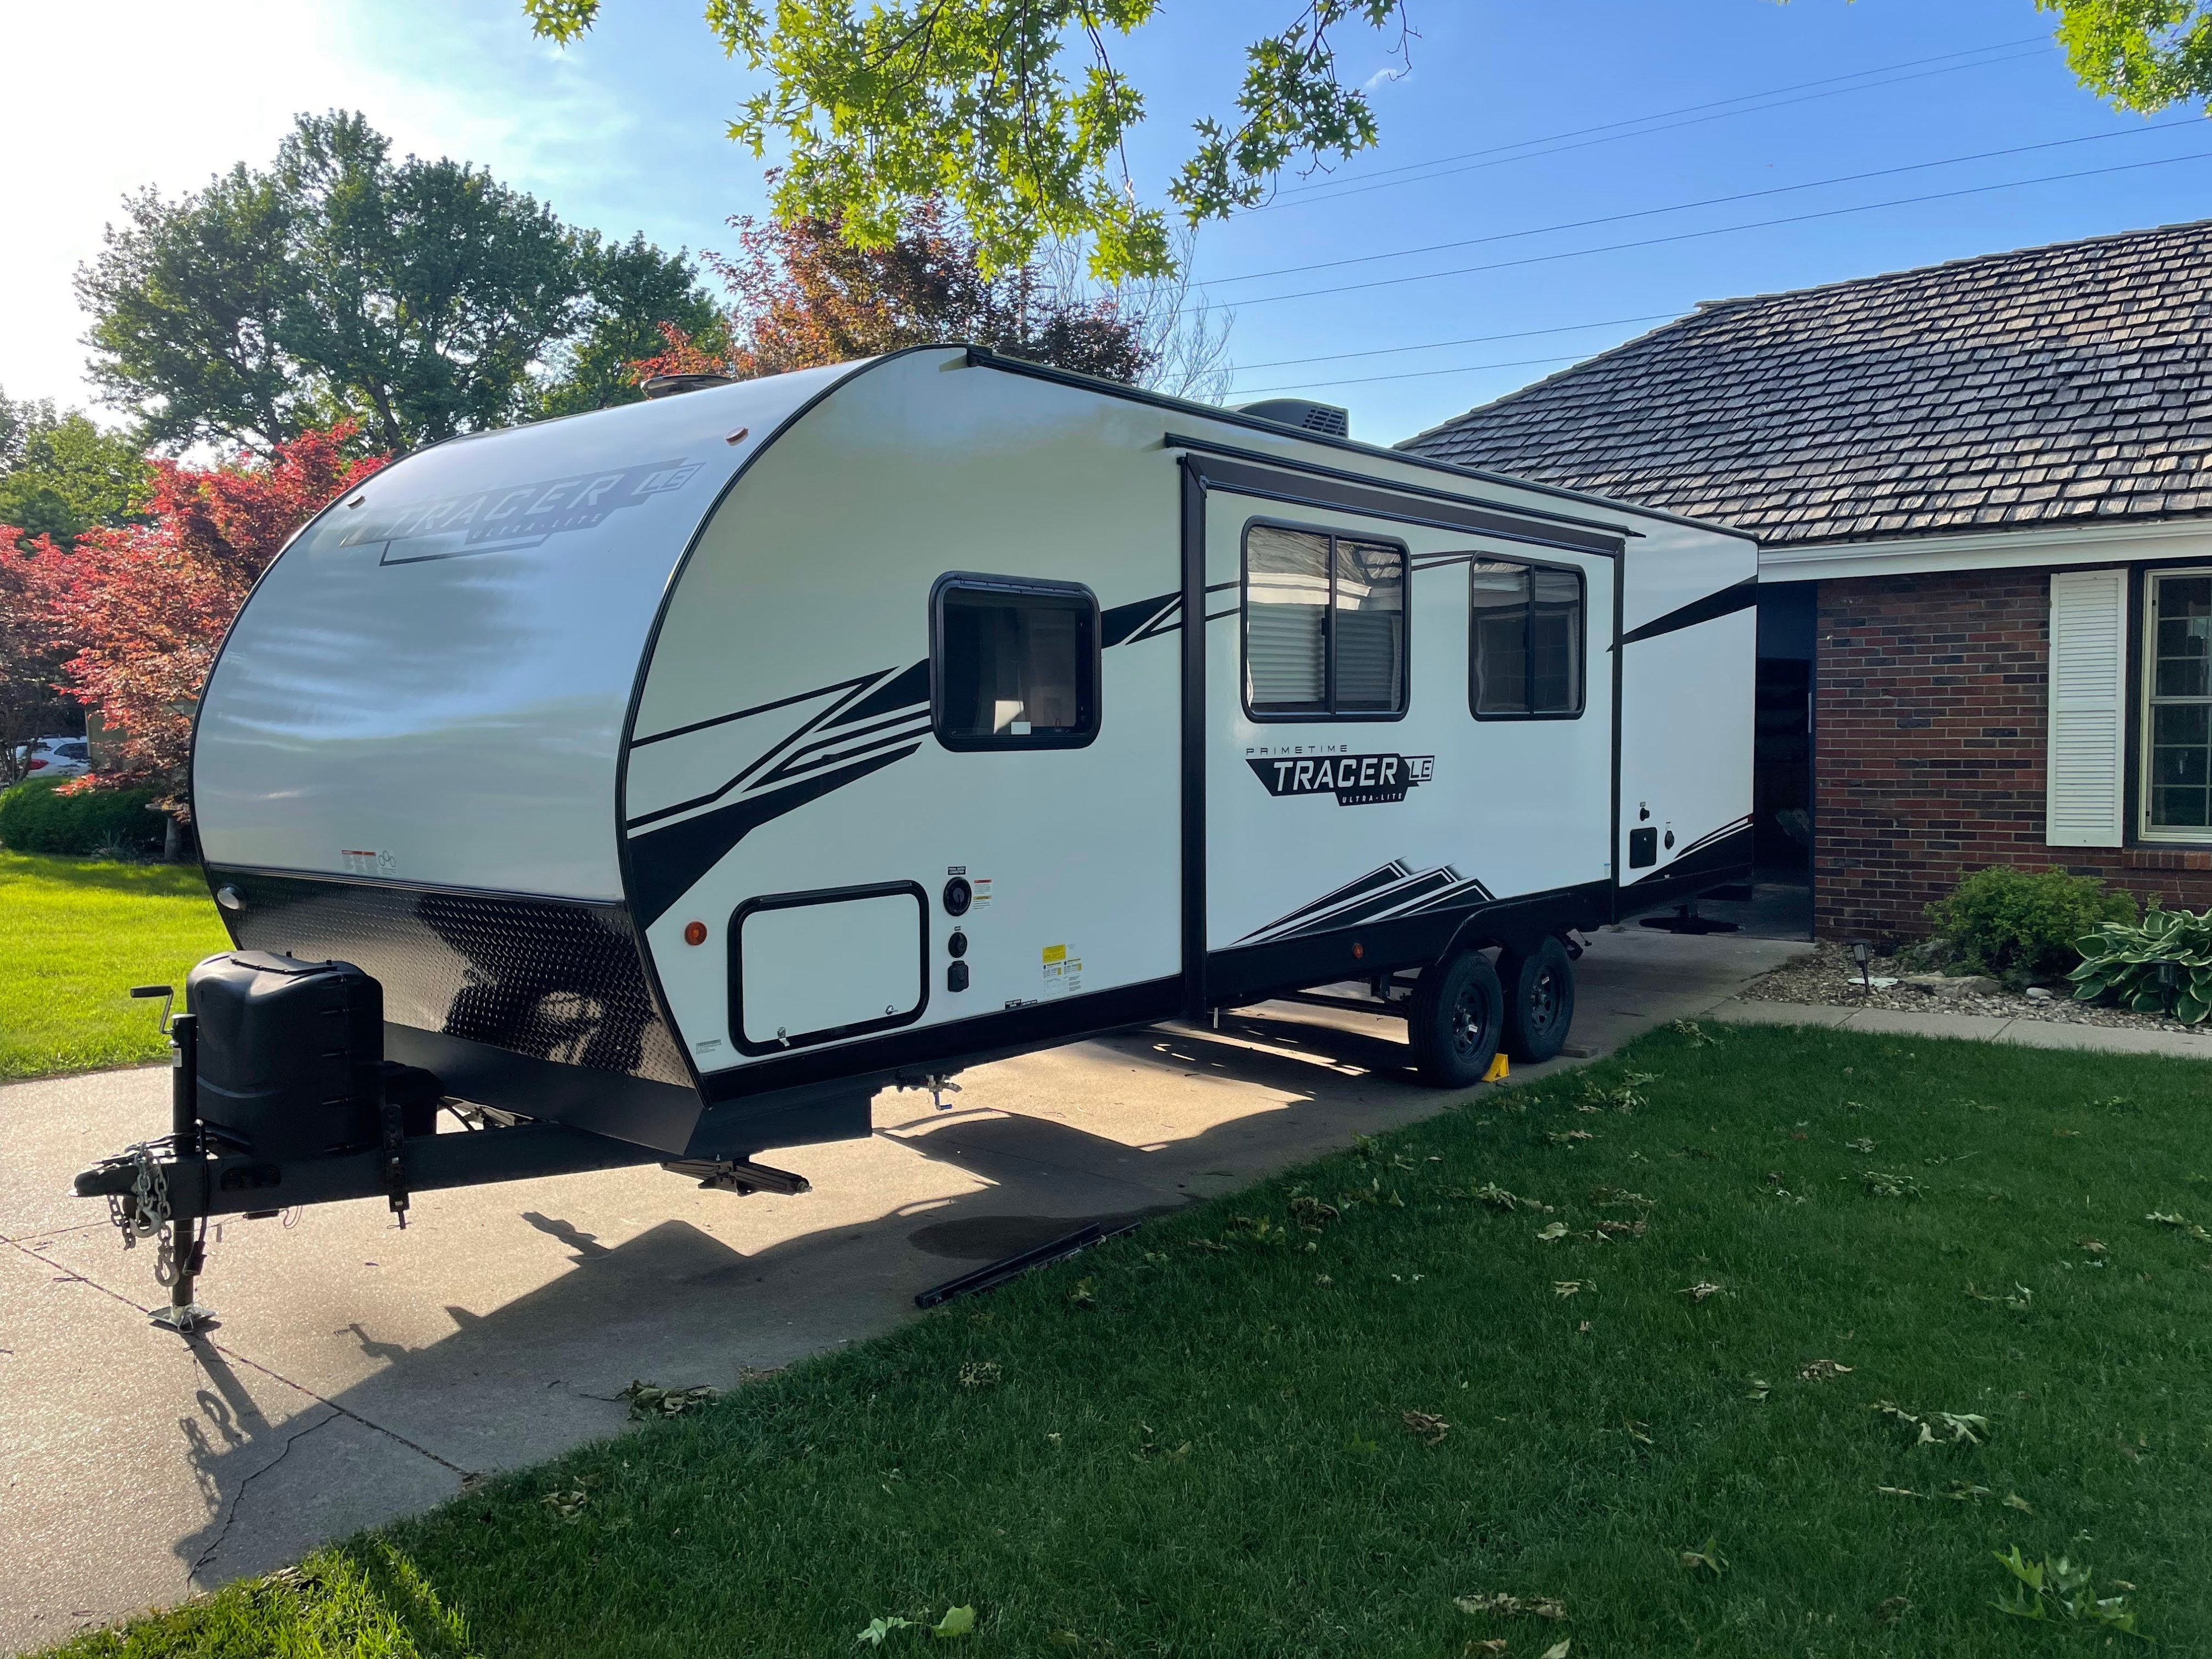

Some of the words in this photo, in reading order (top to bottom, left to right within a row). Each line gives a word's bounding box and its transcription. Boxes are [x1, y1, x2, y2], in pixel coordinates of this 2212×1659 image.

[383, 473, 625, 536] TRACER
[642, 470, 689, 492] LE
[1246, 744, 1348, 756] PRIMETIME
[1274, 757, 1398, 791] TRACER
[1410, 760, 1432, 779] LE
[1342, 792, 1402, 804] ULTRA-LITE
